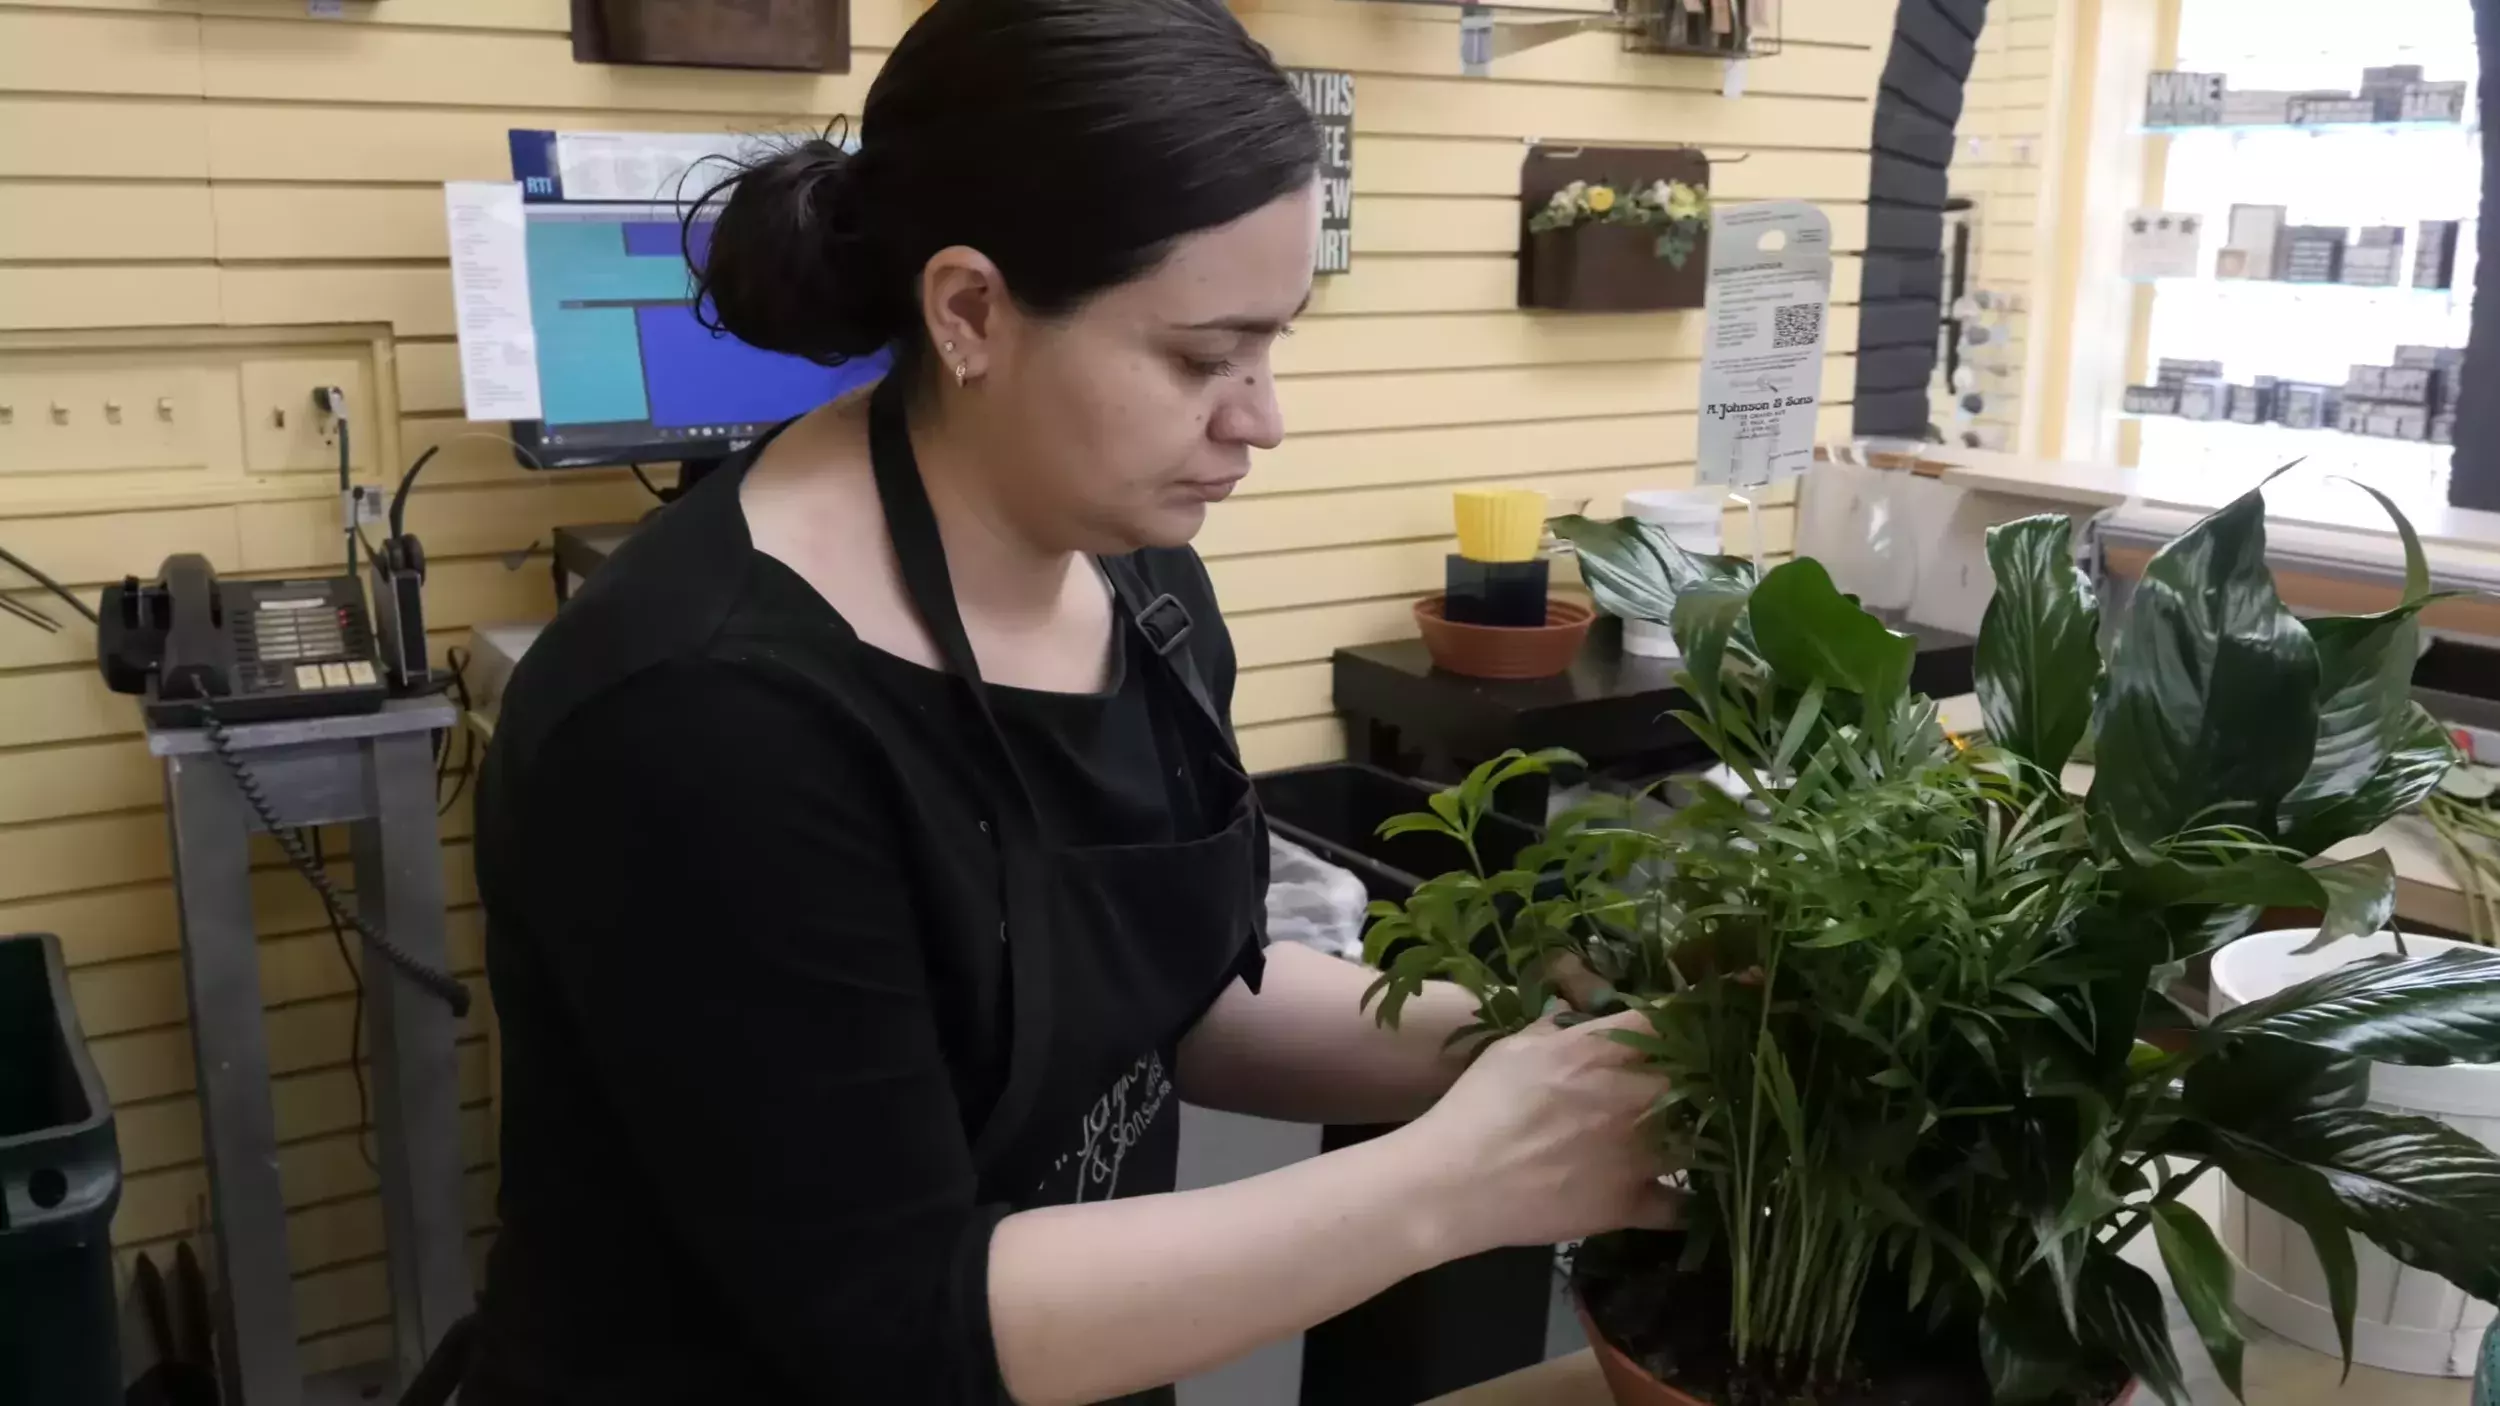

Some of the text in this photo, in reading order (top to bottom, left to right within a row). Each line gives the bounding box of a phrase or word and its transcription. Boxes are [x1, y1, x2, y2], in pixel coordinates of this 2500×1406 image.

[1719, 402, 1769, 420] Johnson
[1785, 396, 1814, 406] Sons
[1092, 1145, 1111, 1183] &
